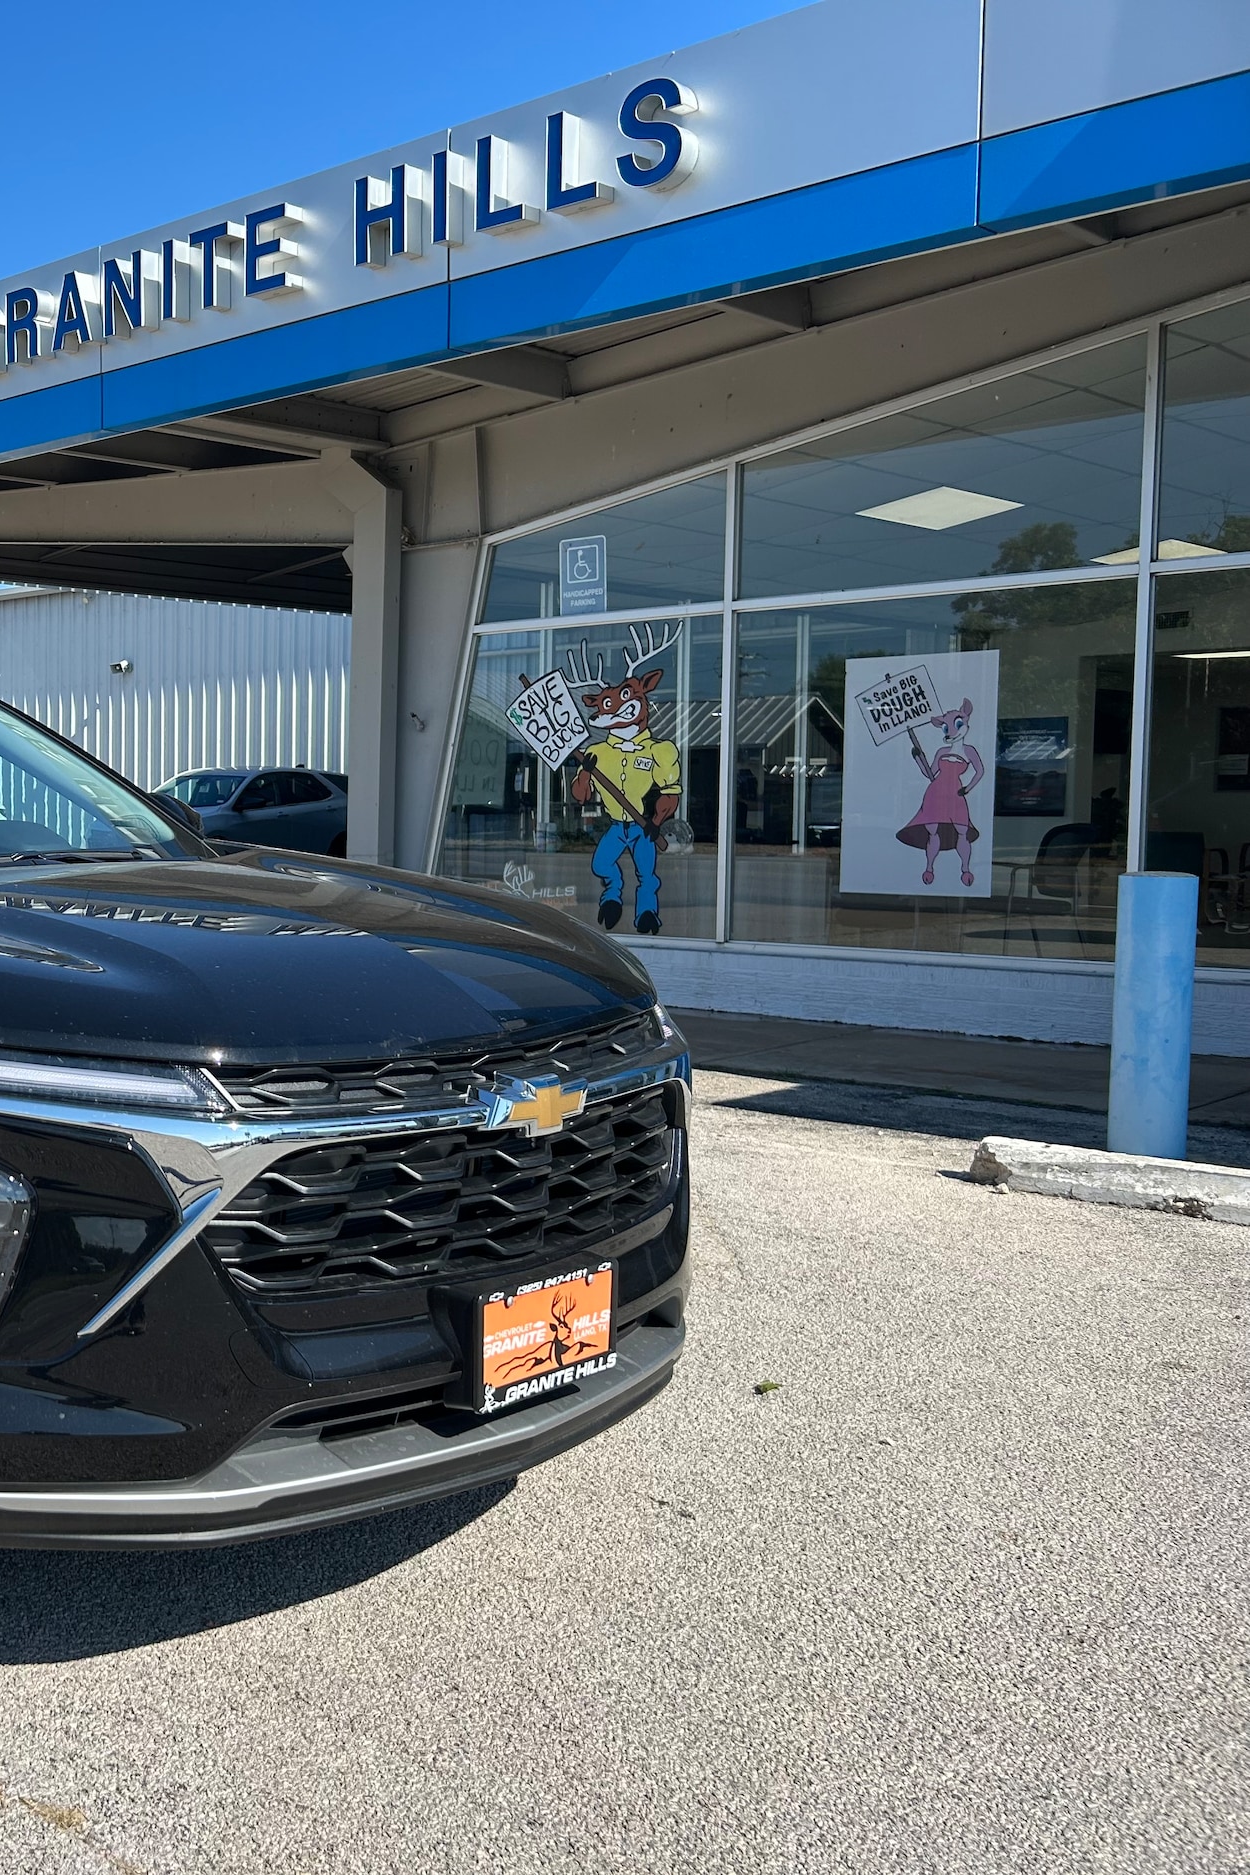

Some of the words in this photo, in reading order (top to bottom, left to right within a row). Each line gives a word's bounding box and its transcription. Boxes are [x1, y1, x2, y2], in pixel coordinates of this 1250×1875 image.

[354, 77, 698, 268] HILLS
[563, 588, 603, 598] HANDICAPPED
[570, 598, 596, 607] PARKING
[518, 676, 563, 720] SAVE
[873, 686, 898, 702] Save
[899, 675, 918, 689] BIG
[869, 684, 927, 723] DOUGH
[892, 701, 932, 727] LLANO!
[526, 701, 570, 743] BIG
[541, 717, 585, 763] BUCKS
[531, 885, 575, 899] HILLS
[516, 1281, 543, 1296] (325)
[494, 1322, 533, 1340] CHEVROLET
[572, 1309, 610, 1332] HILLS
[598, 1323, 607, 1332] TX
[483, 1328, 547, 1358] GRANITE
[505, 1366, 574, 1402] GRANITE
[575, 1352, 618, 1380] HILLS
